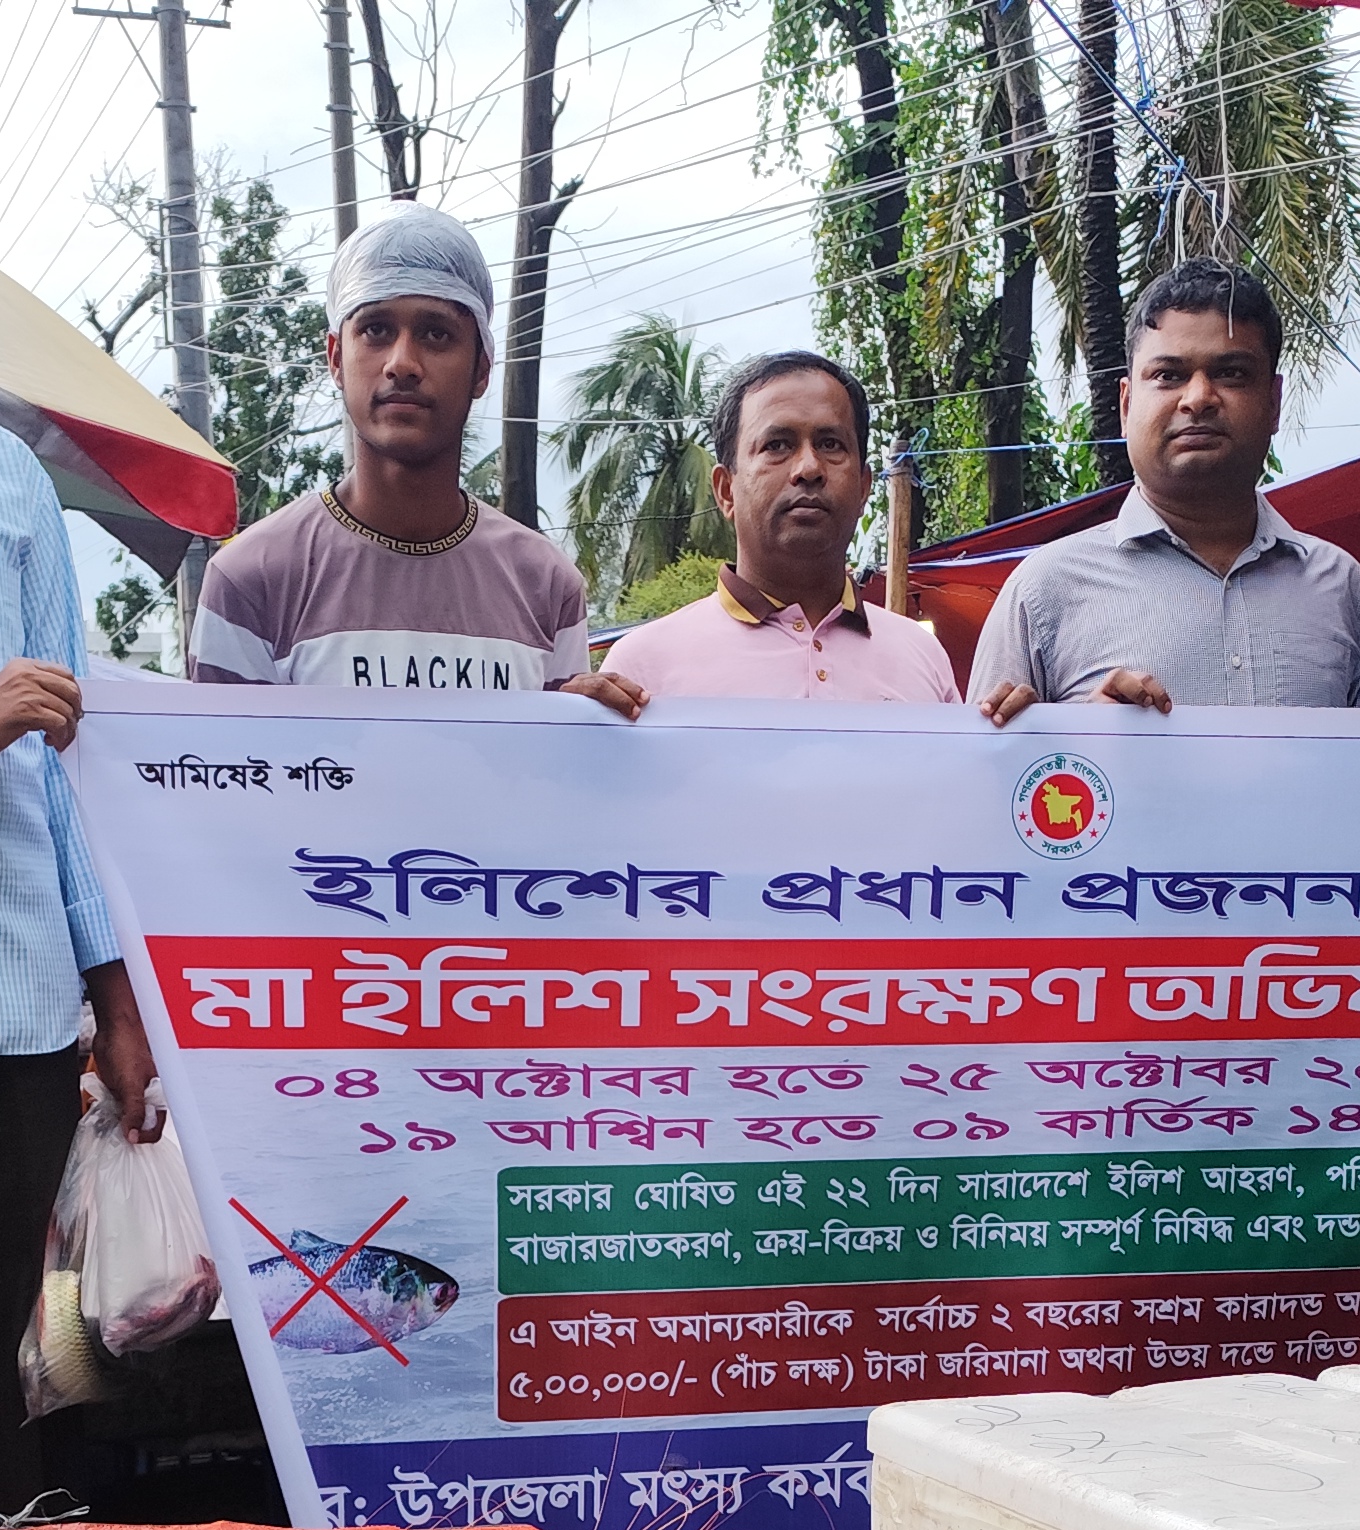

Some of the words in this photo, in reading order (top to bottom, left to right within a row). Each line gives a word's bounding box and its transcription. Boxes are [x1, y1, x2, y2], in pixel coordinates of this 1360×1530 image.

[133, 754, 274, 794] আমিষেই
[282, 757, 355, 792] শক্তি
[1071, 760, 1108, 802] বাংলাদেশ
[1041, 840, 1083, 854] সরকার
[290, 848, 724, 923] ইলিশের
[762, 865, 1029, 922] প্রধান
[183, 968, 312, 1027] মা
[335, 946, 649, 1035] ইলিশ
[671, 968, 1105, 1032] সংরক্ষণ
[275, 1069, 379, 1098] ০৪
[414, 1059, 697, 1099] অক্টোবর
[720, 1065, 870, 1100] হতে
[900, 1064, 1000, 1096] ২৫
[1024, 1051, 1279, 1089] অক্টোবর
[360, 1122, 456, 1153] ১৯
[484, 1109, 713, 1151] আশ্বিন
[735, 1116, 883, 1151] হতে
[913, 1112, 1009, 1140] ০৯
[1035, 1096, 1259, 1139] কার্তিক
[505, 1181, 614, 1213] সরকার
[635, 1172, 737, 1210] ঘোষিত
[758, 1170, 806, 1209] এই
[827, 1178, 869, 1207] ২২
[887, 1167, 941, 1202] দিন
[957, 1168, 1091, 1200] সারাদেশে
[1107, 1160, 1185, 1198] ইলিশ
[1200, 1163, 1304, 1198] আহরণ,
[506, 1228, 741, 1264] বাজারজাতকরণ,
[753, 1219, 904, 1256] ক্রয়-বিক্রয়
[916, 1226, 938, 1248] ও
[949, 1213, 1051, 1249] বিনিময়
[1058, 1208, 1145, 1254] সম্পূর্ণ
[1151, 1208, 1235, 1244] নিষিদ্ধ
[1247, 1216, 1306, 1242] এবং
[510, 1322, 535, 1347] এ
[549, 1310, 638, 1347] আইন
[648, 1301, 853, 1342] অমান্যকারীকে
[876, 1296, 978, 1332] সর্বোচ্চ
[992, 1304, 1012, 1331] ২
[1024, 1301, 1121, 1328] বছরের
[1132, 1297, 1203, 1323] সশ্রম
[510, 1361, 697, 1403] ৫,০০,০০০/-
[712, 1353, 778, 1396] (পাঁচ
[786, 1354, 853, 1391] লক্ষ)
[864, 1348, 927, 1381] টাকা
[937, 1343, 1049, 1377] জরিমানা
[1058, 1345, 1135, 1372] অথবা
[1146, 1339, 1209, 1367] উভয়
[388, 1467, 607, 1525] উপজেলা
[621, 1464, 750, 1516] মৎস্য
